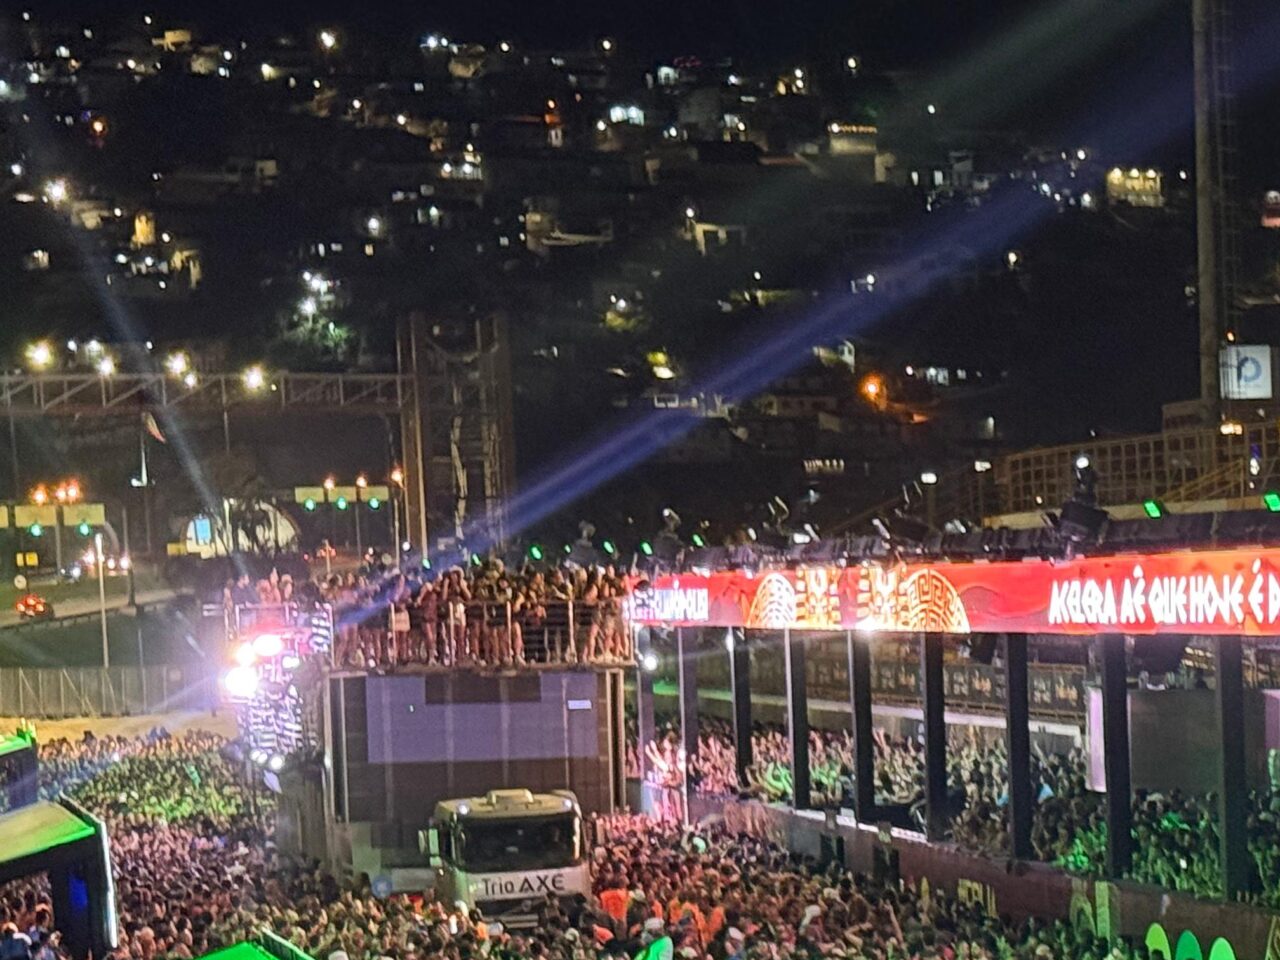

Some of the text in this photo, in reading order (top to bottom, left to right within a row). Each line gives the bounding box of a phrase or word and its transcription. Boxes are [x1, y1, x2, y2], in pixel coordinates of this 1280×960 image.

[1148, 575, 1189, 624] QUE
[1189, 574, 1245, 624] HOJE
[1248, 557, 1265, 624] É
[482, 872, 565, 896] Trio AXE
